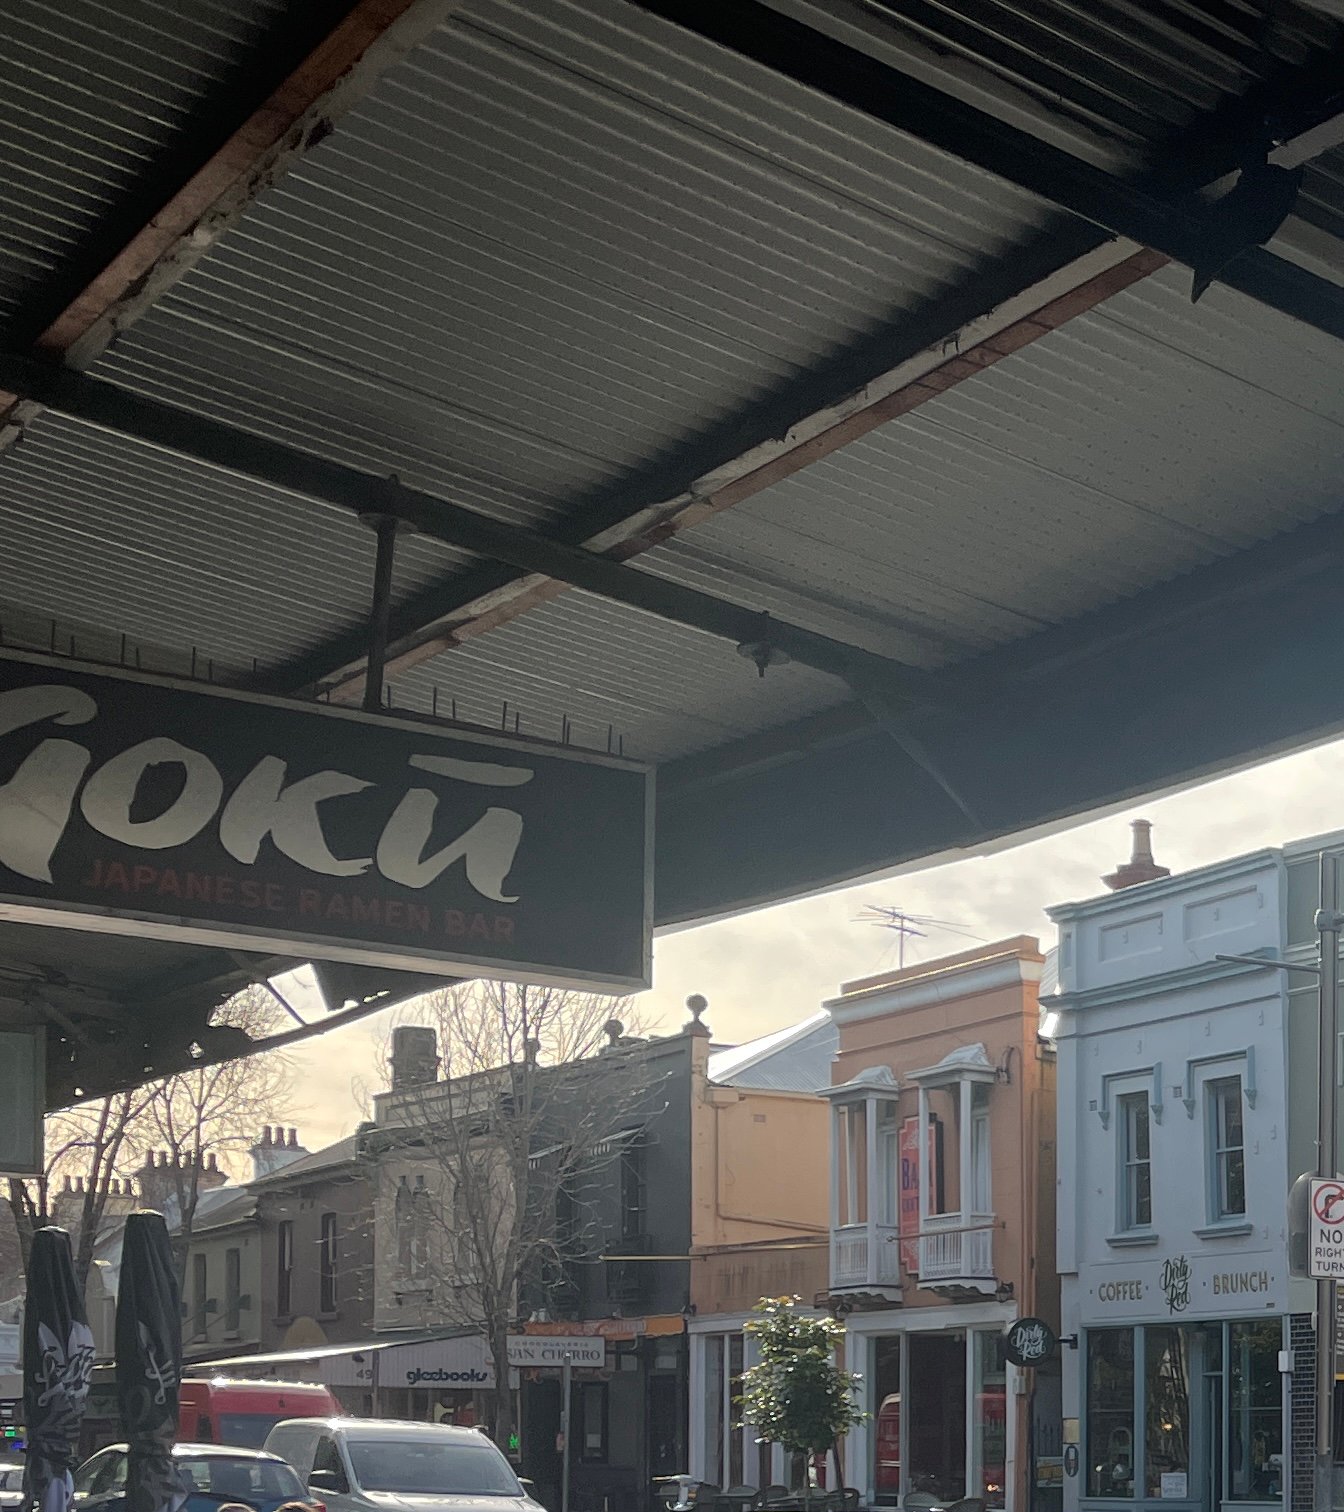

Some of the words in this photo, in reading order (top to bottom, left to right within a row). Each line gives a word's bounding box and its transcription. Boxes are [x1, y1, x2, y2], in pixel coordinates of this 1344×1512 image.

[84, 858, 286, 912] JAPANESE
[299, 886, 432, 933] RAMEN
[443, 908, 516, 943] BAR
[1320, 1229, 1343, 1244] NO
[1159, 1254, 1193, 1291] Dirty
[1213, 1270, 1268, 1295] BRUNCH
[1098, 1279, 1143, 1302] COFFEE
[1165, 1282, 1191, 1316] Red
[1011, 1324, 1047, 1348] Dirty
[1018, 1339, 1047, 1361] Red
[356, 1369, 373, 1380] 49
